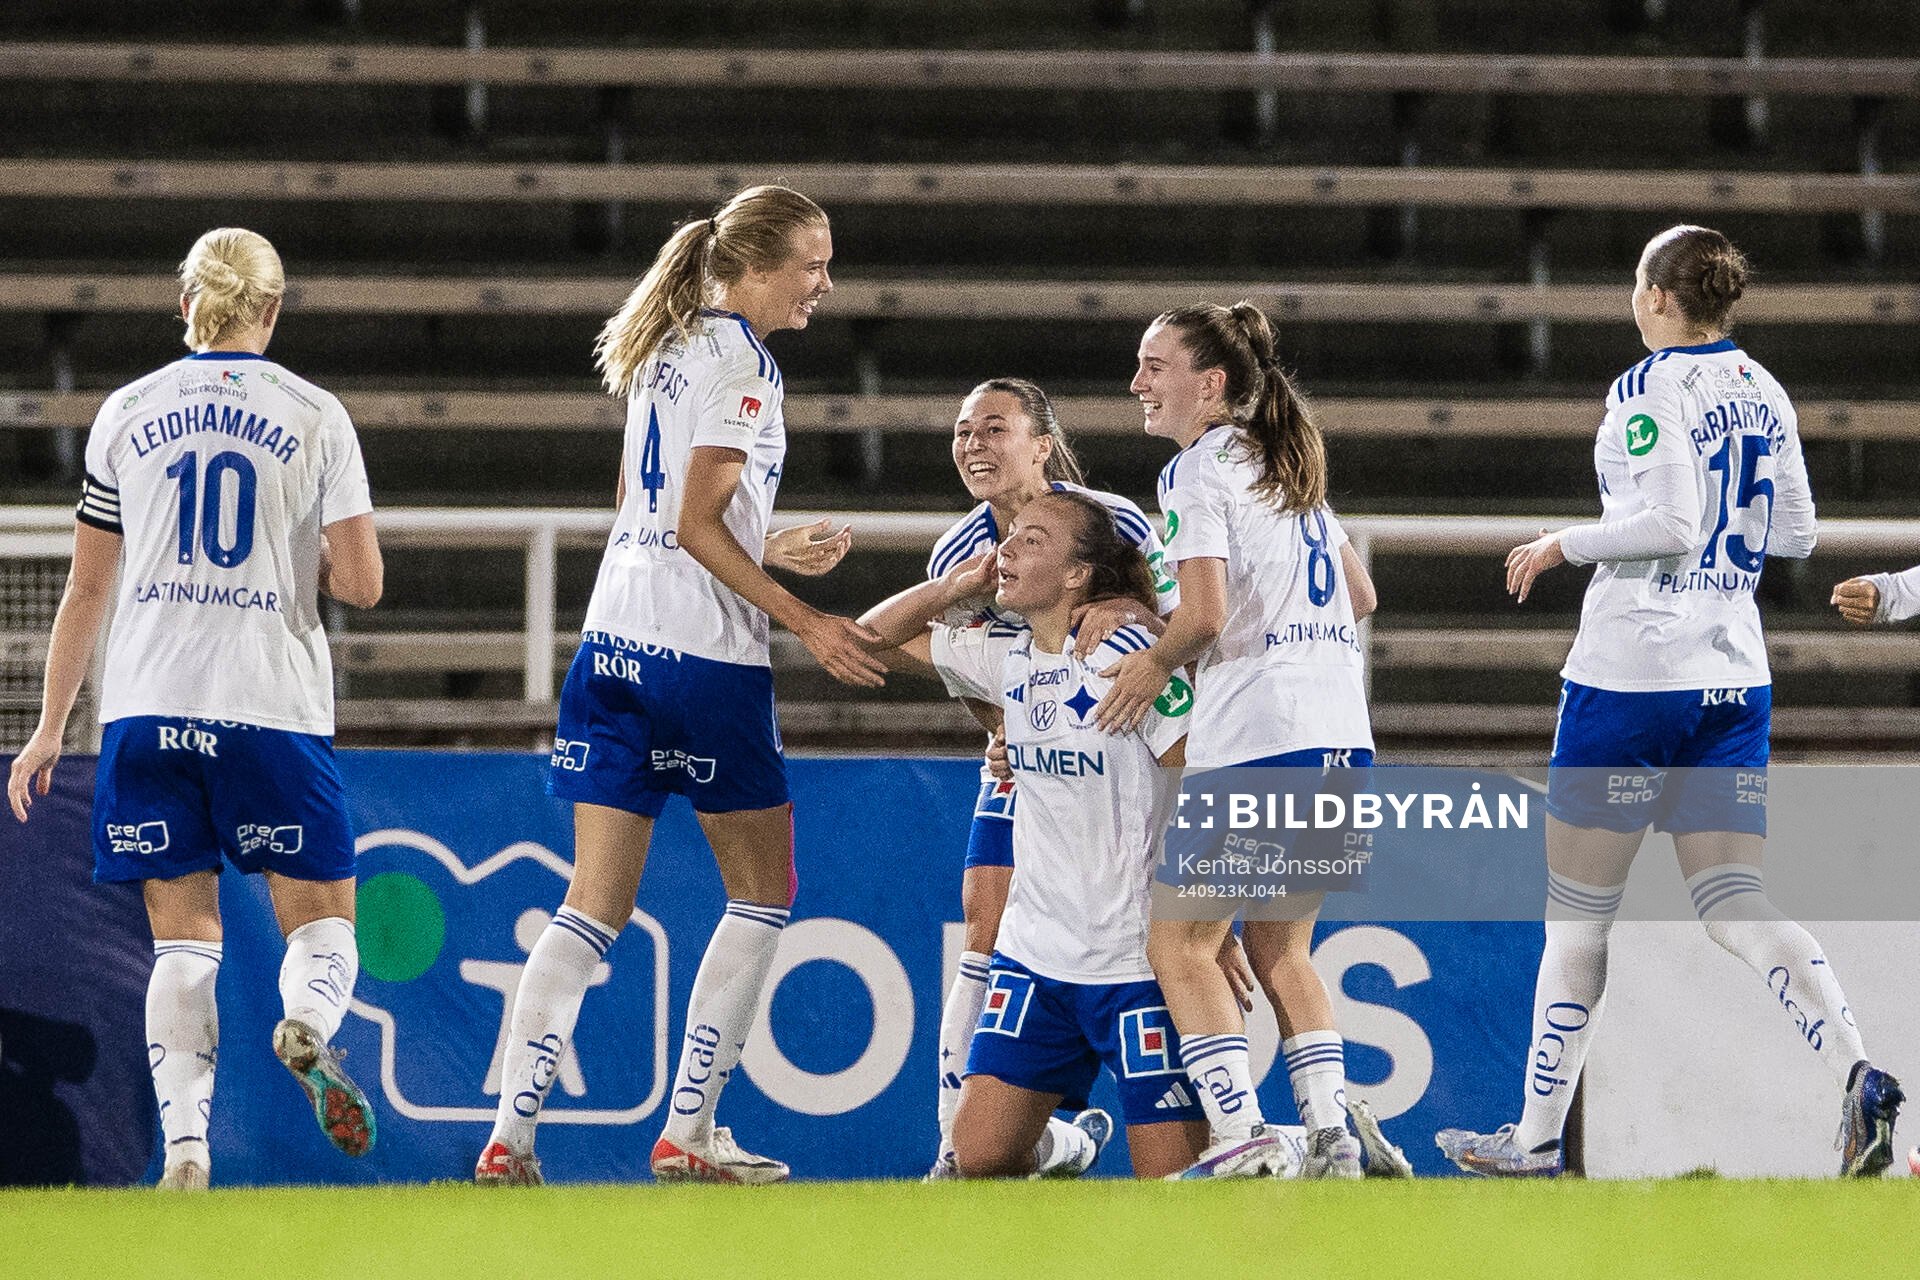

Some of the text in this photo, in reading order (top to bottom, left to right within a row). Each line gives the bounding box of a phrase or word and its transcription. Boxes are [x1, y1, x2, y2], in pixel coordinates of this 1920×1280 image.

[130, 403, 300, 465] LEIDHAMMAR
[641, 402, 665, 513] 4
[166, 451, 257, 569] 10
[1699, 435, 1775, 573] 15
[1300, 511, 1335, 608] 8
[594, 650, 642, 685] RÖR
[157, 723, 218, 757] RÖR
[1607, 789, 1652, 804] zero
[1608, 775, 1645, 789] pre
[107, 823, 136, 839] pre
[111, 839, 152, 854] zero
[237, 823, 272, 841] pre
[240, 836, 283, 855] zero
[1225, 833, 1257, 851] pre
[1532, 1002, 1590, 1097] Ocab
[513, 1033, 563, 1118] Ocab
[674, 1024, 721, 1115] Ocab
